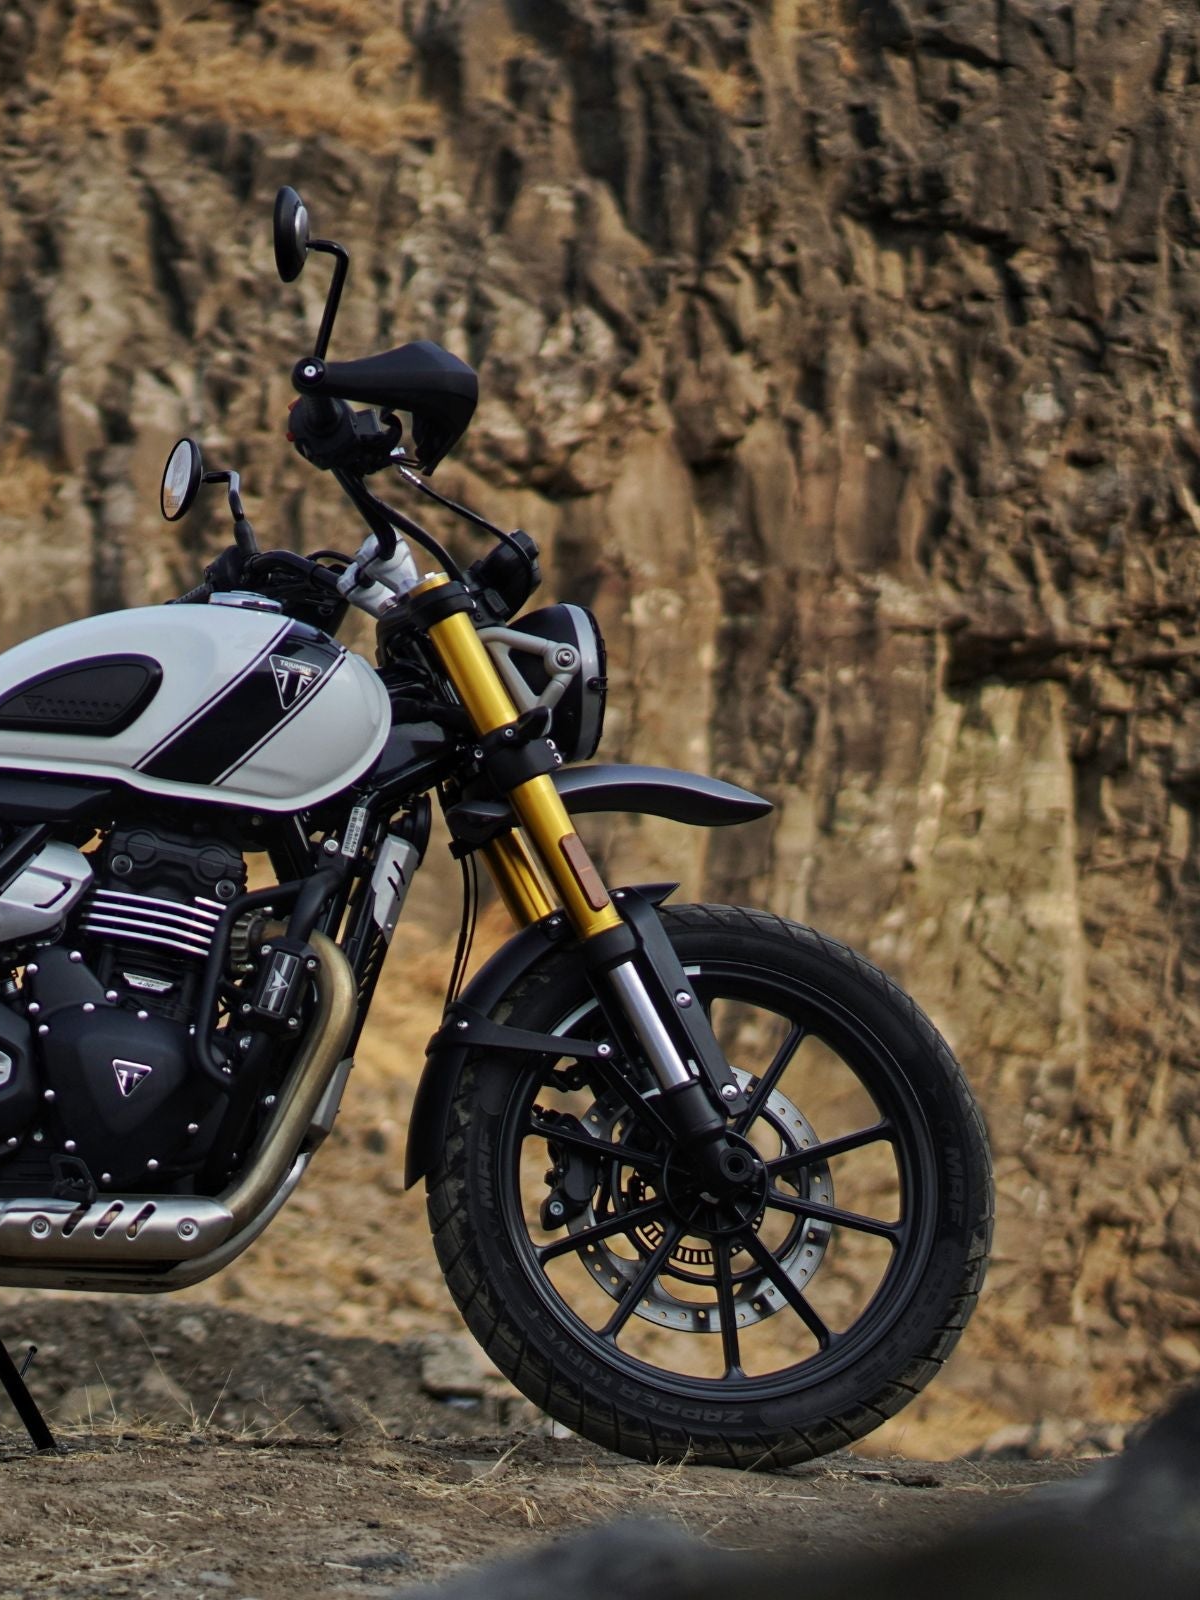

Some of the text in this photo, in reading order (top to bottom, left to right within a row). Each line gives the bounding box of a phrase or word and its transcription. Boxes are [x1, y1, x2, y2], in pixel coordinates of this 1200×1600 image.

[279, 659, 312, 673] TRIUMPH
[942, 1145, 963, 1225] MRF
[616, 1382, 744, 1422] ZAPPER
